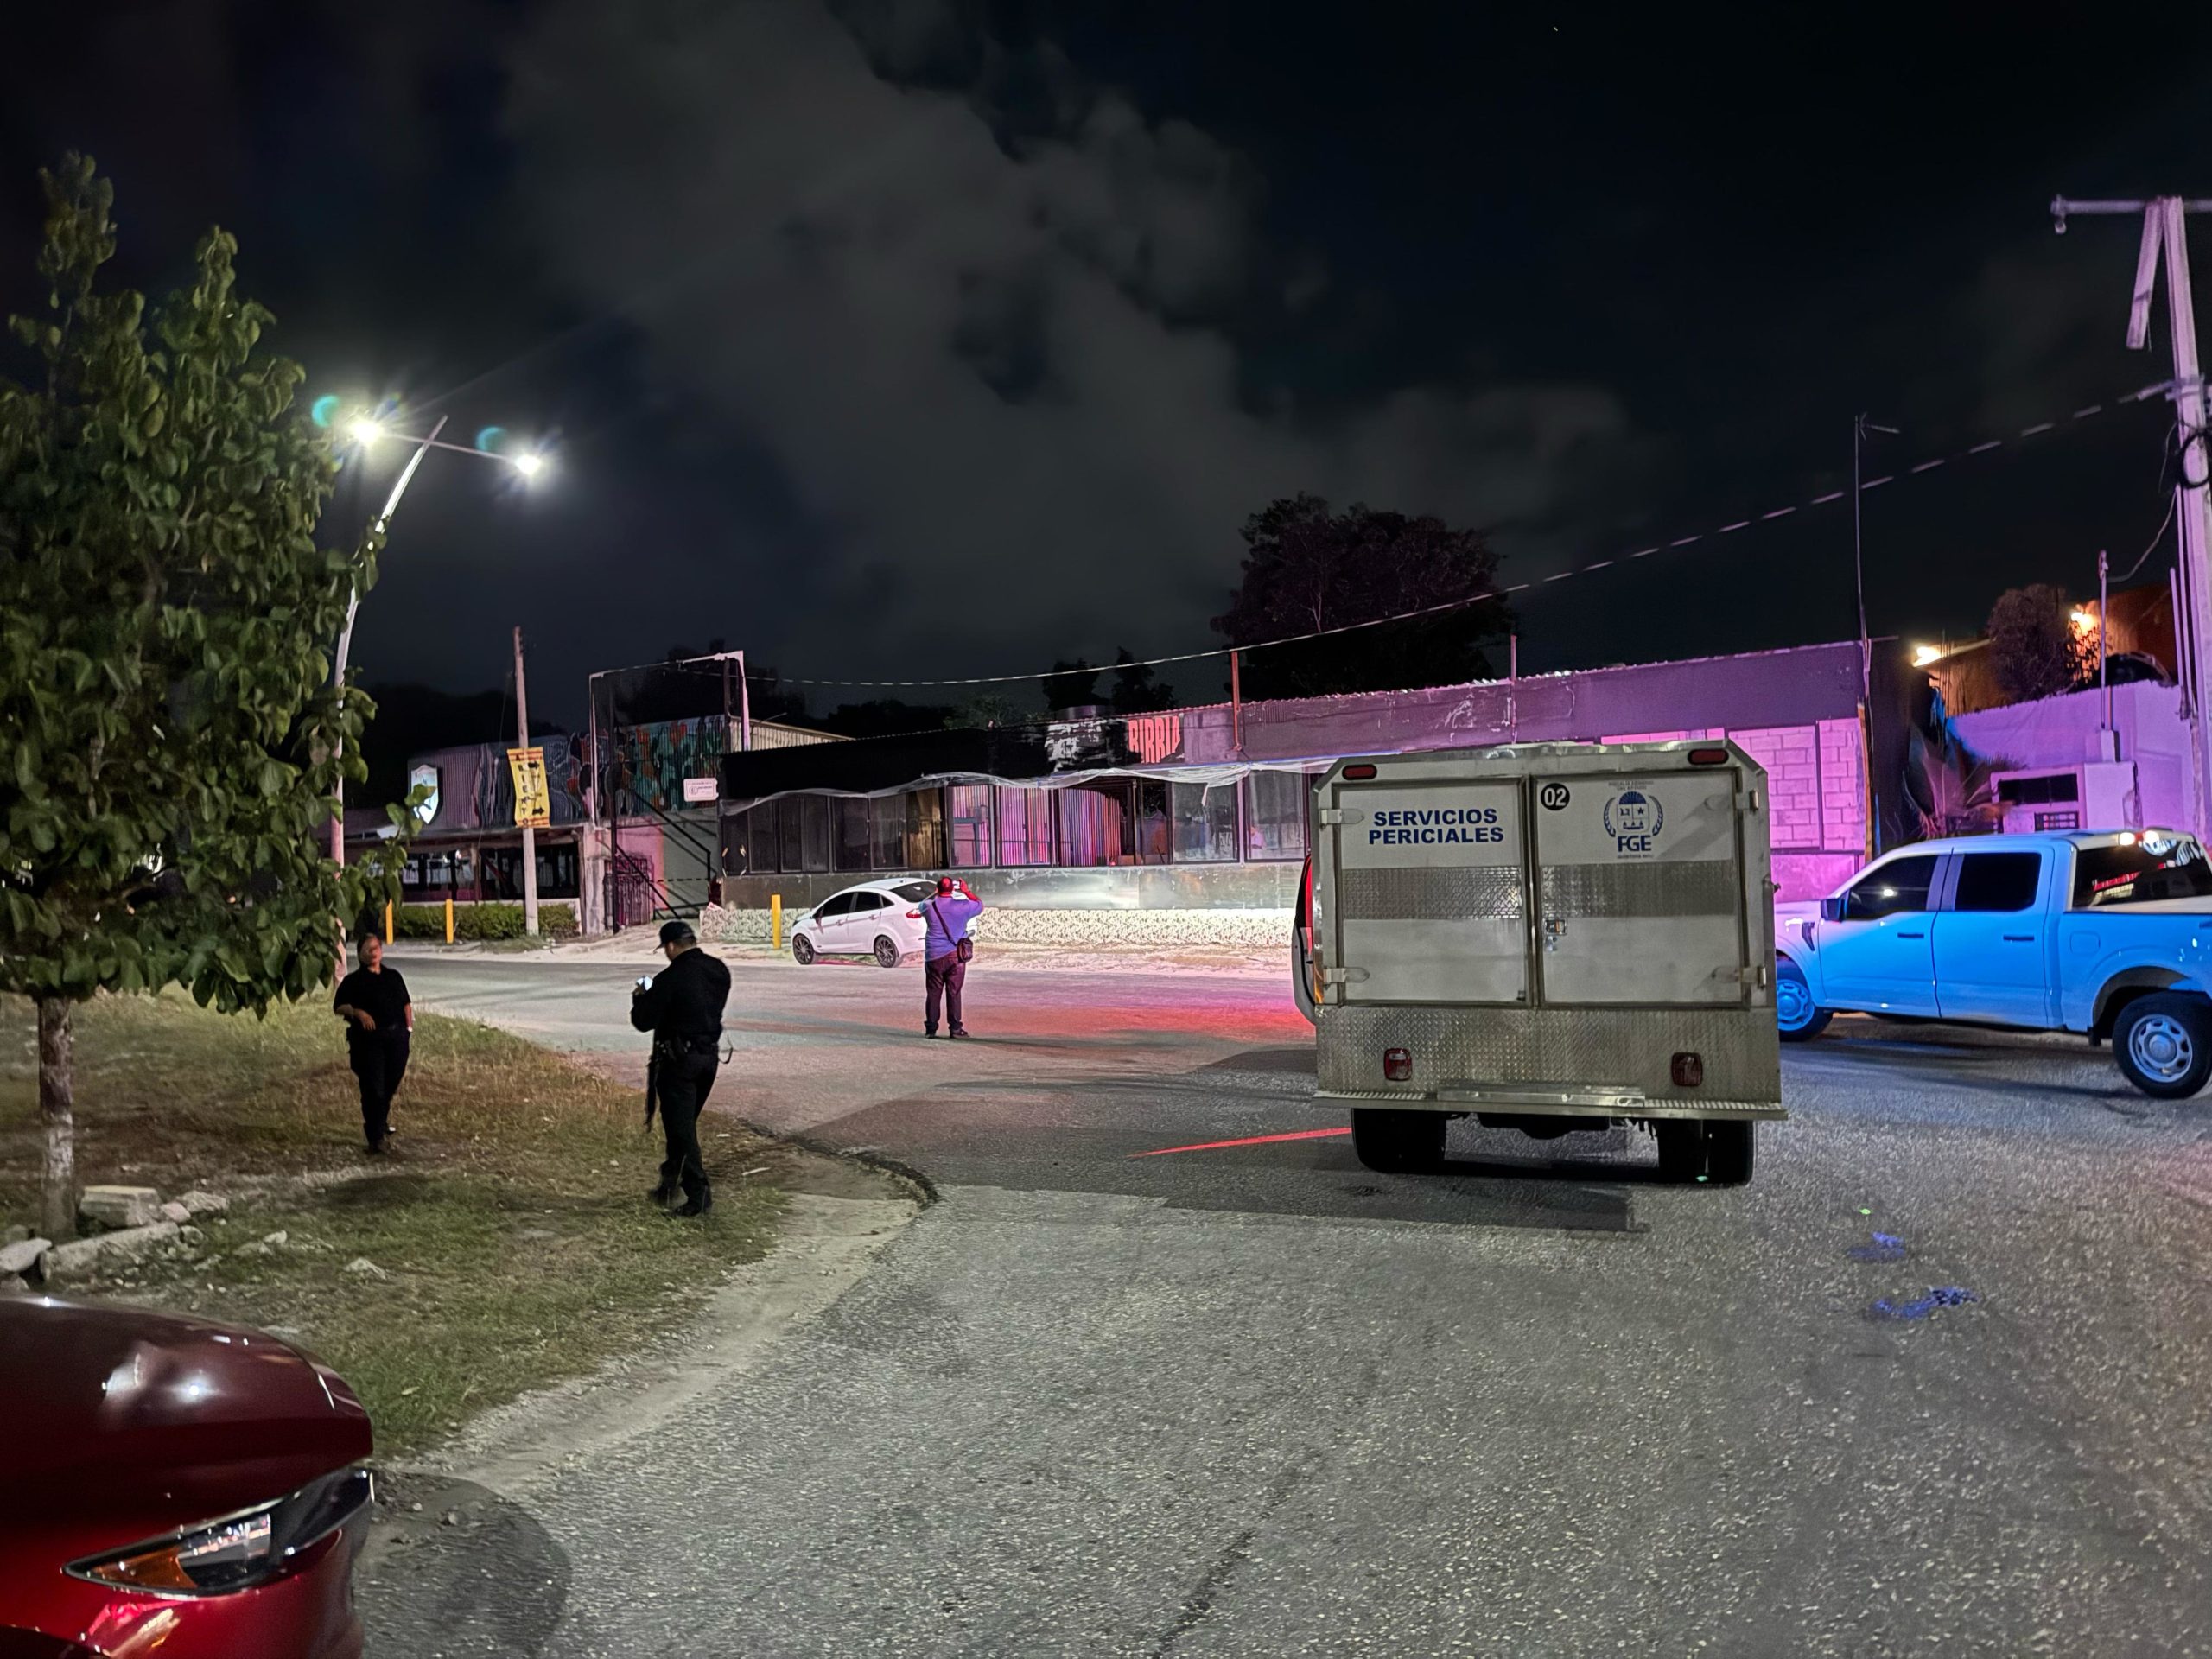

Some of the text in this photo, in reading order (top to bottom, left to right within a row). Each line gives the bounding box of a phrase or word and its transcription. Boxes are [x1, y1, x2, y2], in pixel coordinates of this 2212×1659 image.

[1544, 787, 1567, 806] 02
[1373, 808, 1497, 827] SERVICIOS
[1369, 827, 1504, 844] PERICIALES
[1617, 835, 1652, 852] FGE
